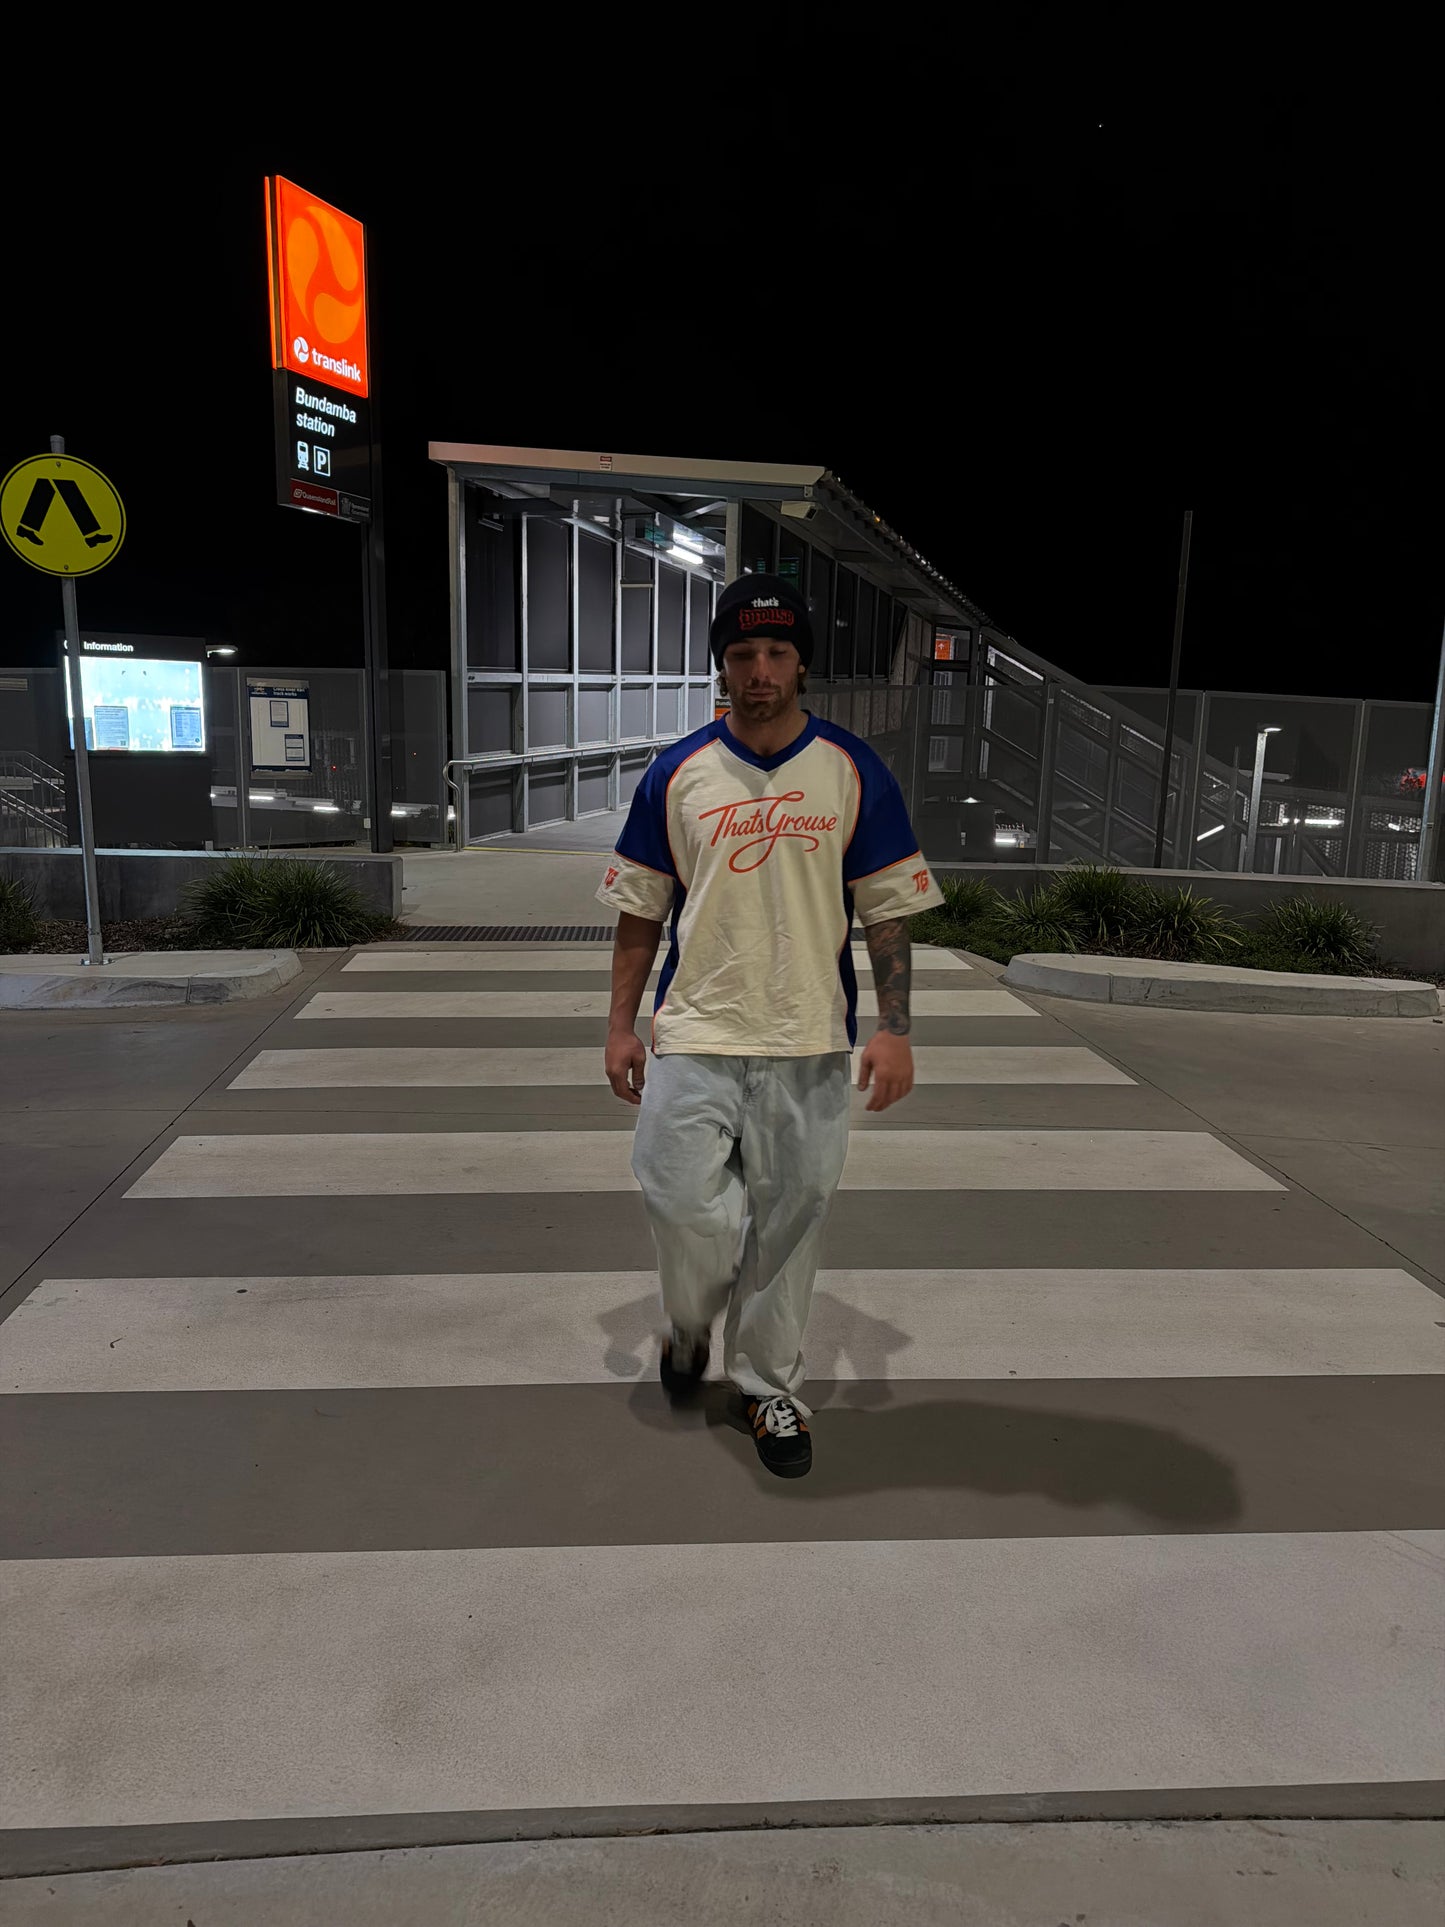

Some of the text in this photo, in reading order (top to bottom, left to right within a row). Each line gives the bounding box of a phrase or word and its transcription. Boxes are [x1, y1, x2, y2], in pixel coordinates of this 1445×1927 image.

[311, 347, 361, 382] translink
[295, 386, 357, 424] Bundamba
[296, 412, 335, 437] station
[317, 450, 327, 470] P
[84, 641, 134, 652] Information
